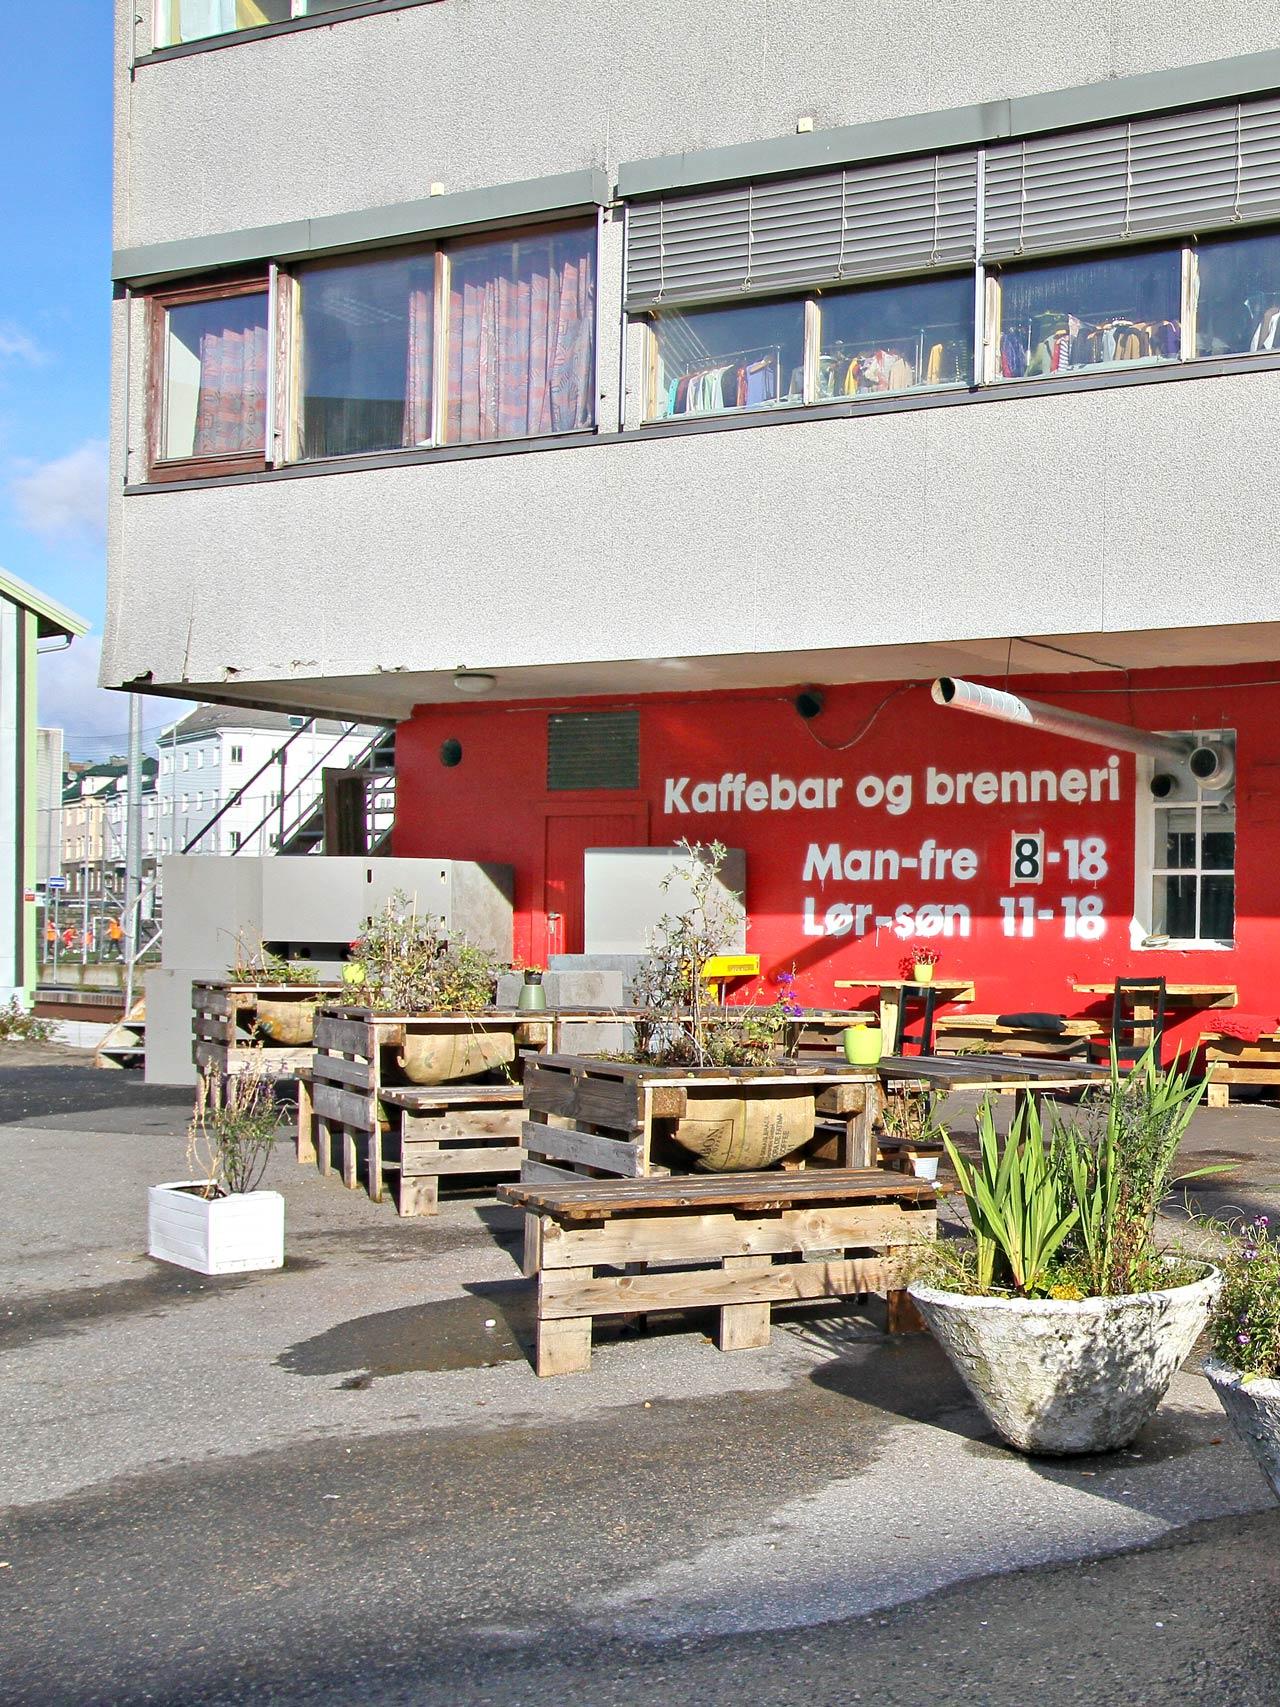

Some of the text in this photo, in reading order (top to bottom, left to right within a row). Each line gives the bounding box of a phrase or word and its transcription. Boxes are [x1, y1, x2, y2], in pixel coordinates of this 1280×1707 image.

[664, 755, 1120, 815] Kaffebar og brenneri
[802, 839, 978, 880] Man-fre
[803, 897, 970, 937] Lør-søn
